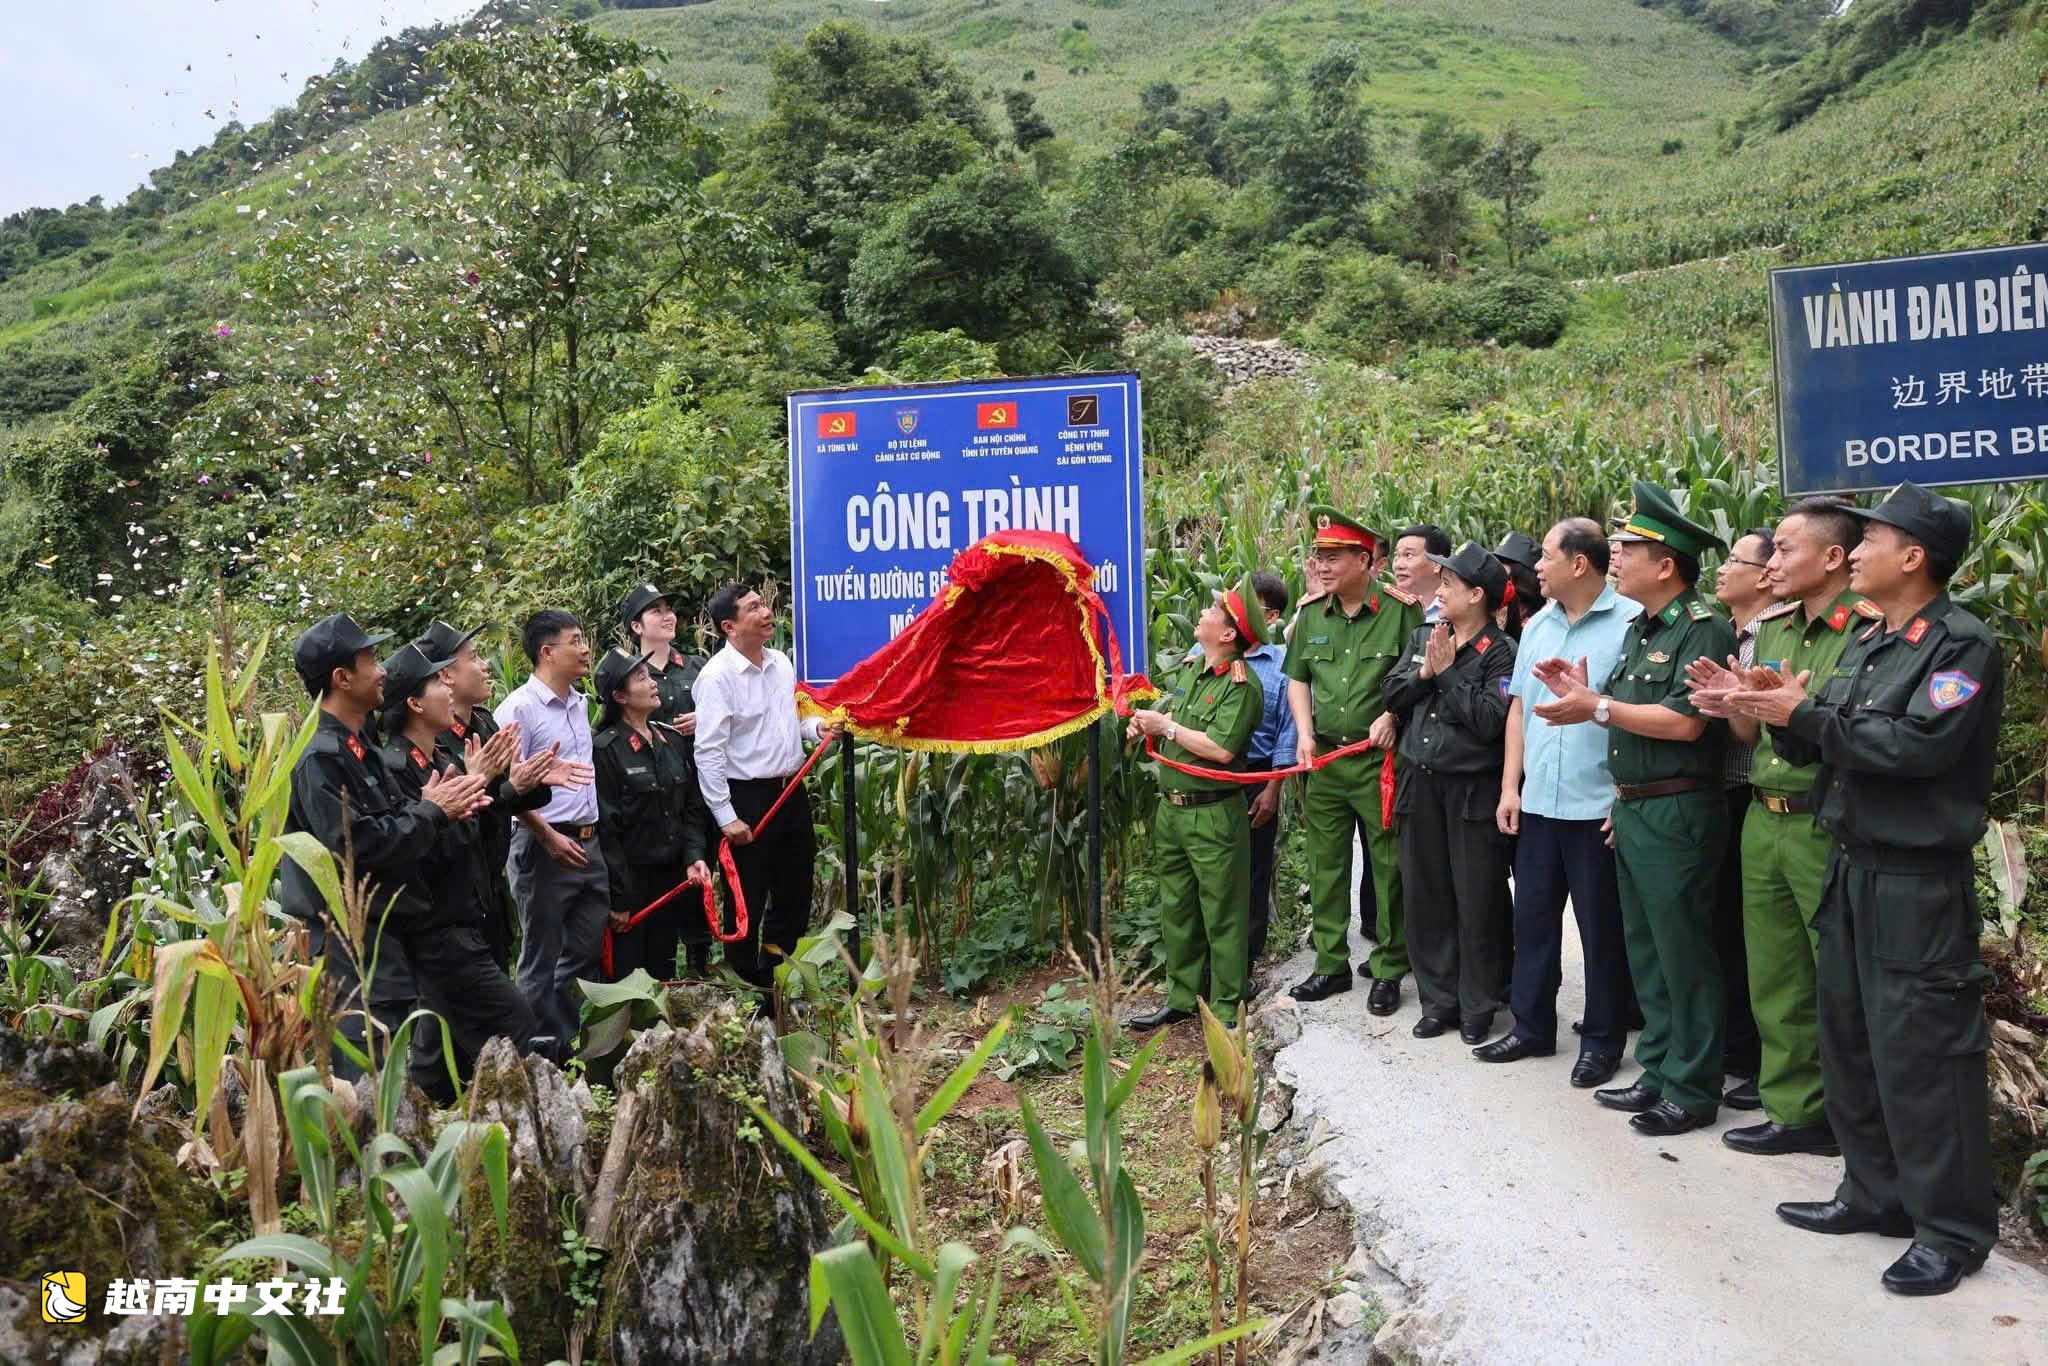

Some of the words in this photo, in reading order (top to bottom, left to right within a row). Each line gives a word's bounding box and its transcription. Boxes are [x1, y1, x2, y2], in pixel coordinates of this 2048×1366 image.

[1803, 282, 1897, 349] VÀNH
[1907, 281, 1967, 341] ĐAI
[973, 435, 988, 445] BAN
[1014, 445, 1039, 456] QUANG
[1058, 430, 1078, 440] CÔNG
[1079, 430, 1089, 439] TY
[1846, 430, 2000, 467] BORDER
[1087, 454, 1112, 464] YOUNG
[847, 481, 951, 553] CÔNG
[962, 475, 1080, 548] TRÌNH
[869, 564, 925, 600] ĐƯỜNG
[889, 603, 921, 641] MỐ
